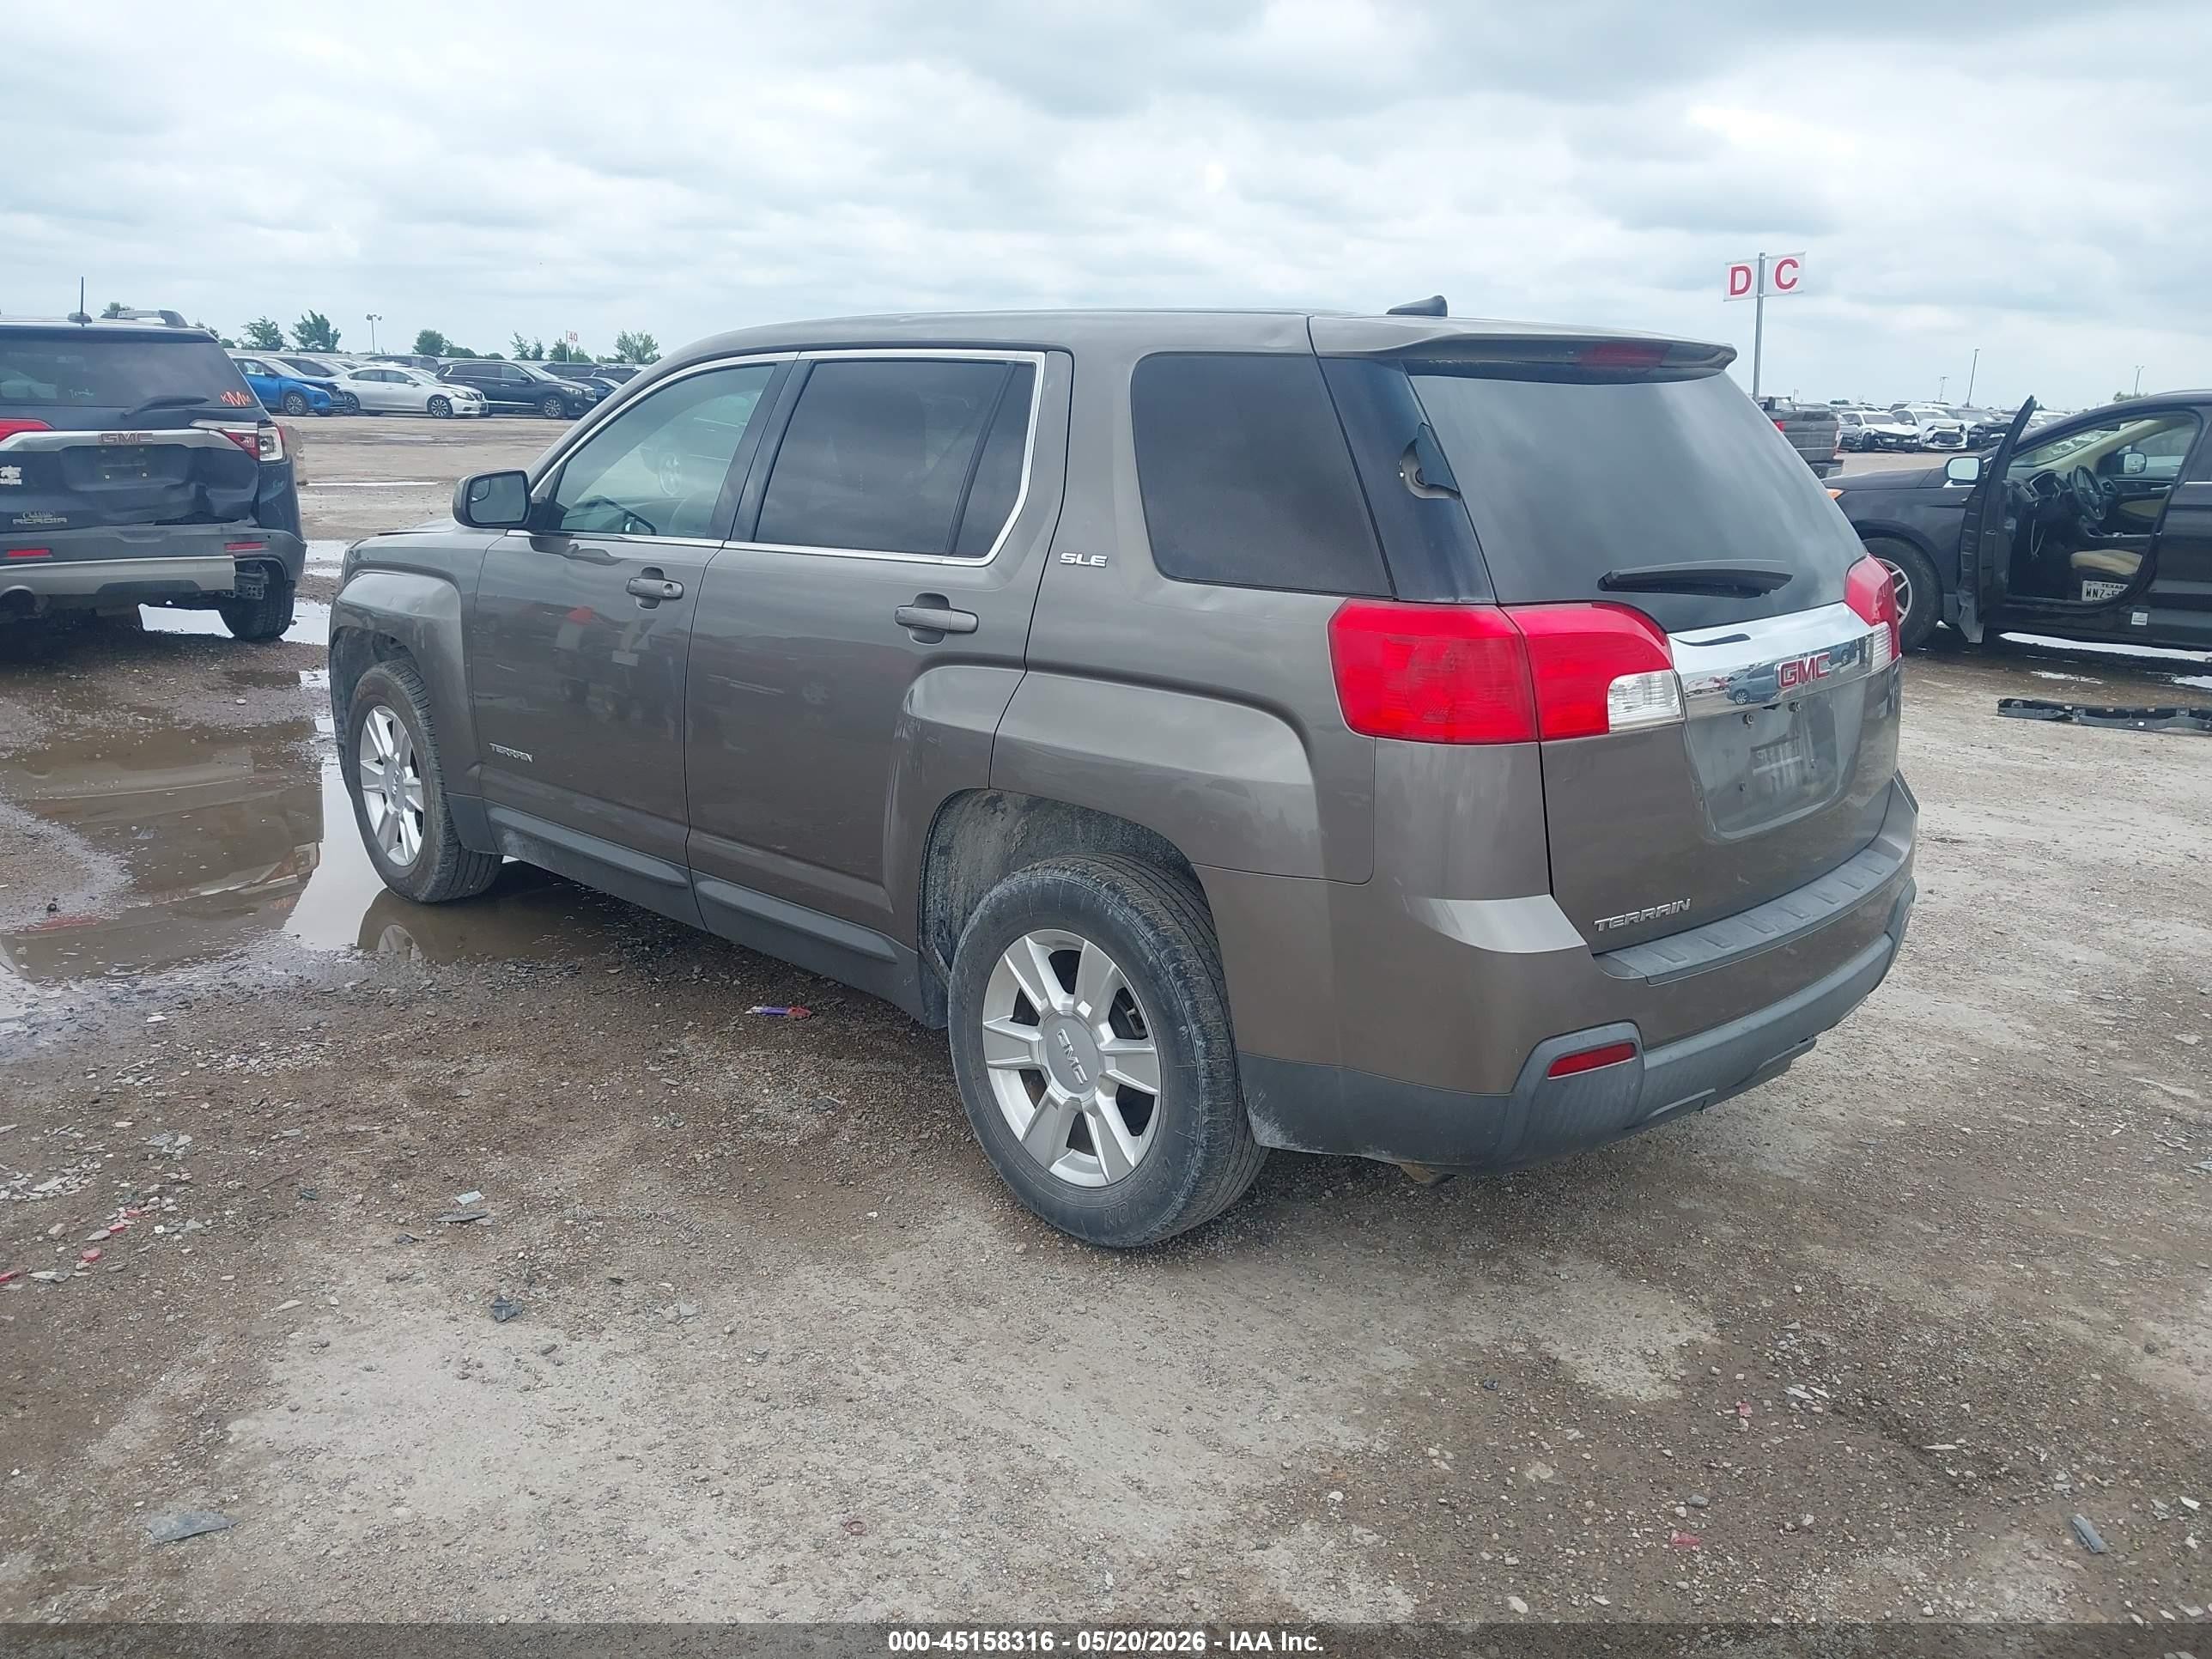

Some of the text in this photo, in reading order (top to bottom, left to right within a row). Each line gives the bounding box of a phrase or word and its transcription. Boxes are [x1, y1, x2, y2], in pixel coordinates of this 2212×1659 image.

[1729, 265, 1753, 296] D
[1774, 258, 1800, 290] C
[568, 331, 578, 343] 40
[100, 432, 154, 445] GMC
[1060, 552, 1108, 568] SLE
[1777, 652, 1832, 688] GMC
[1594, 898, 1692, 933] TERRAIN
[1056, 1028, 1089, 1085] GMC
